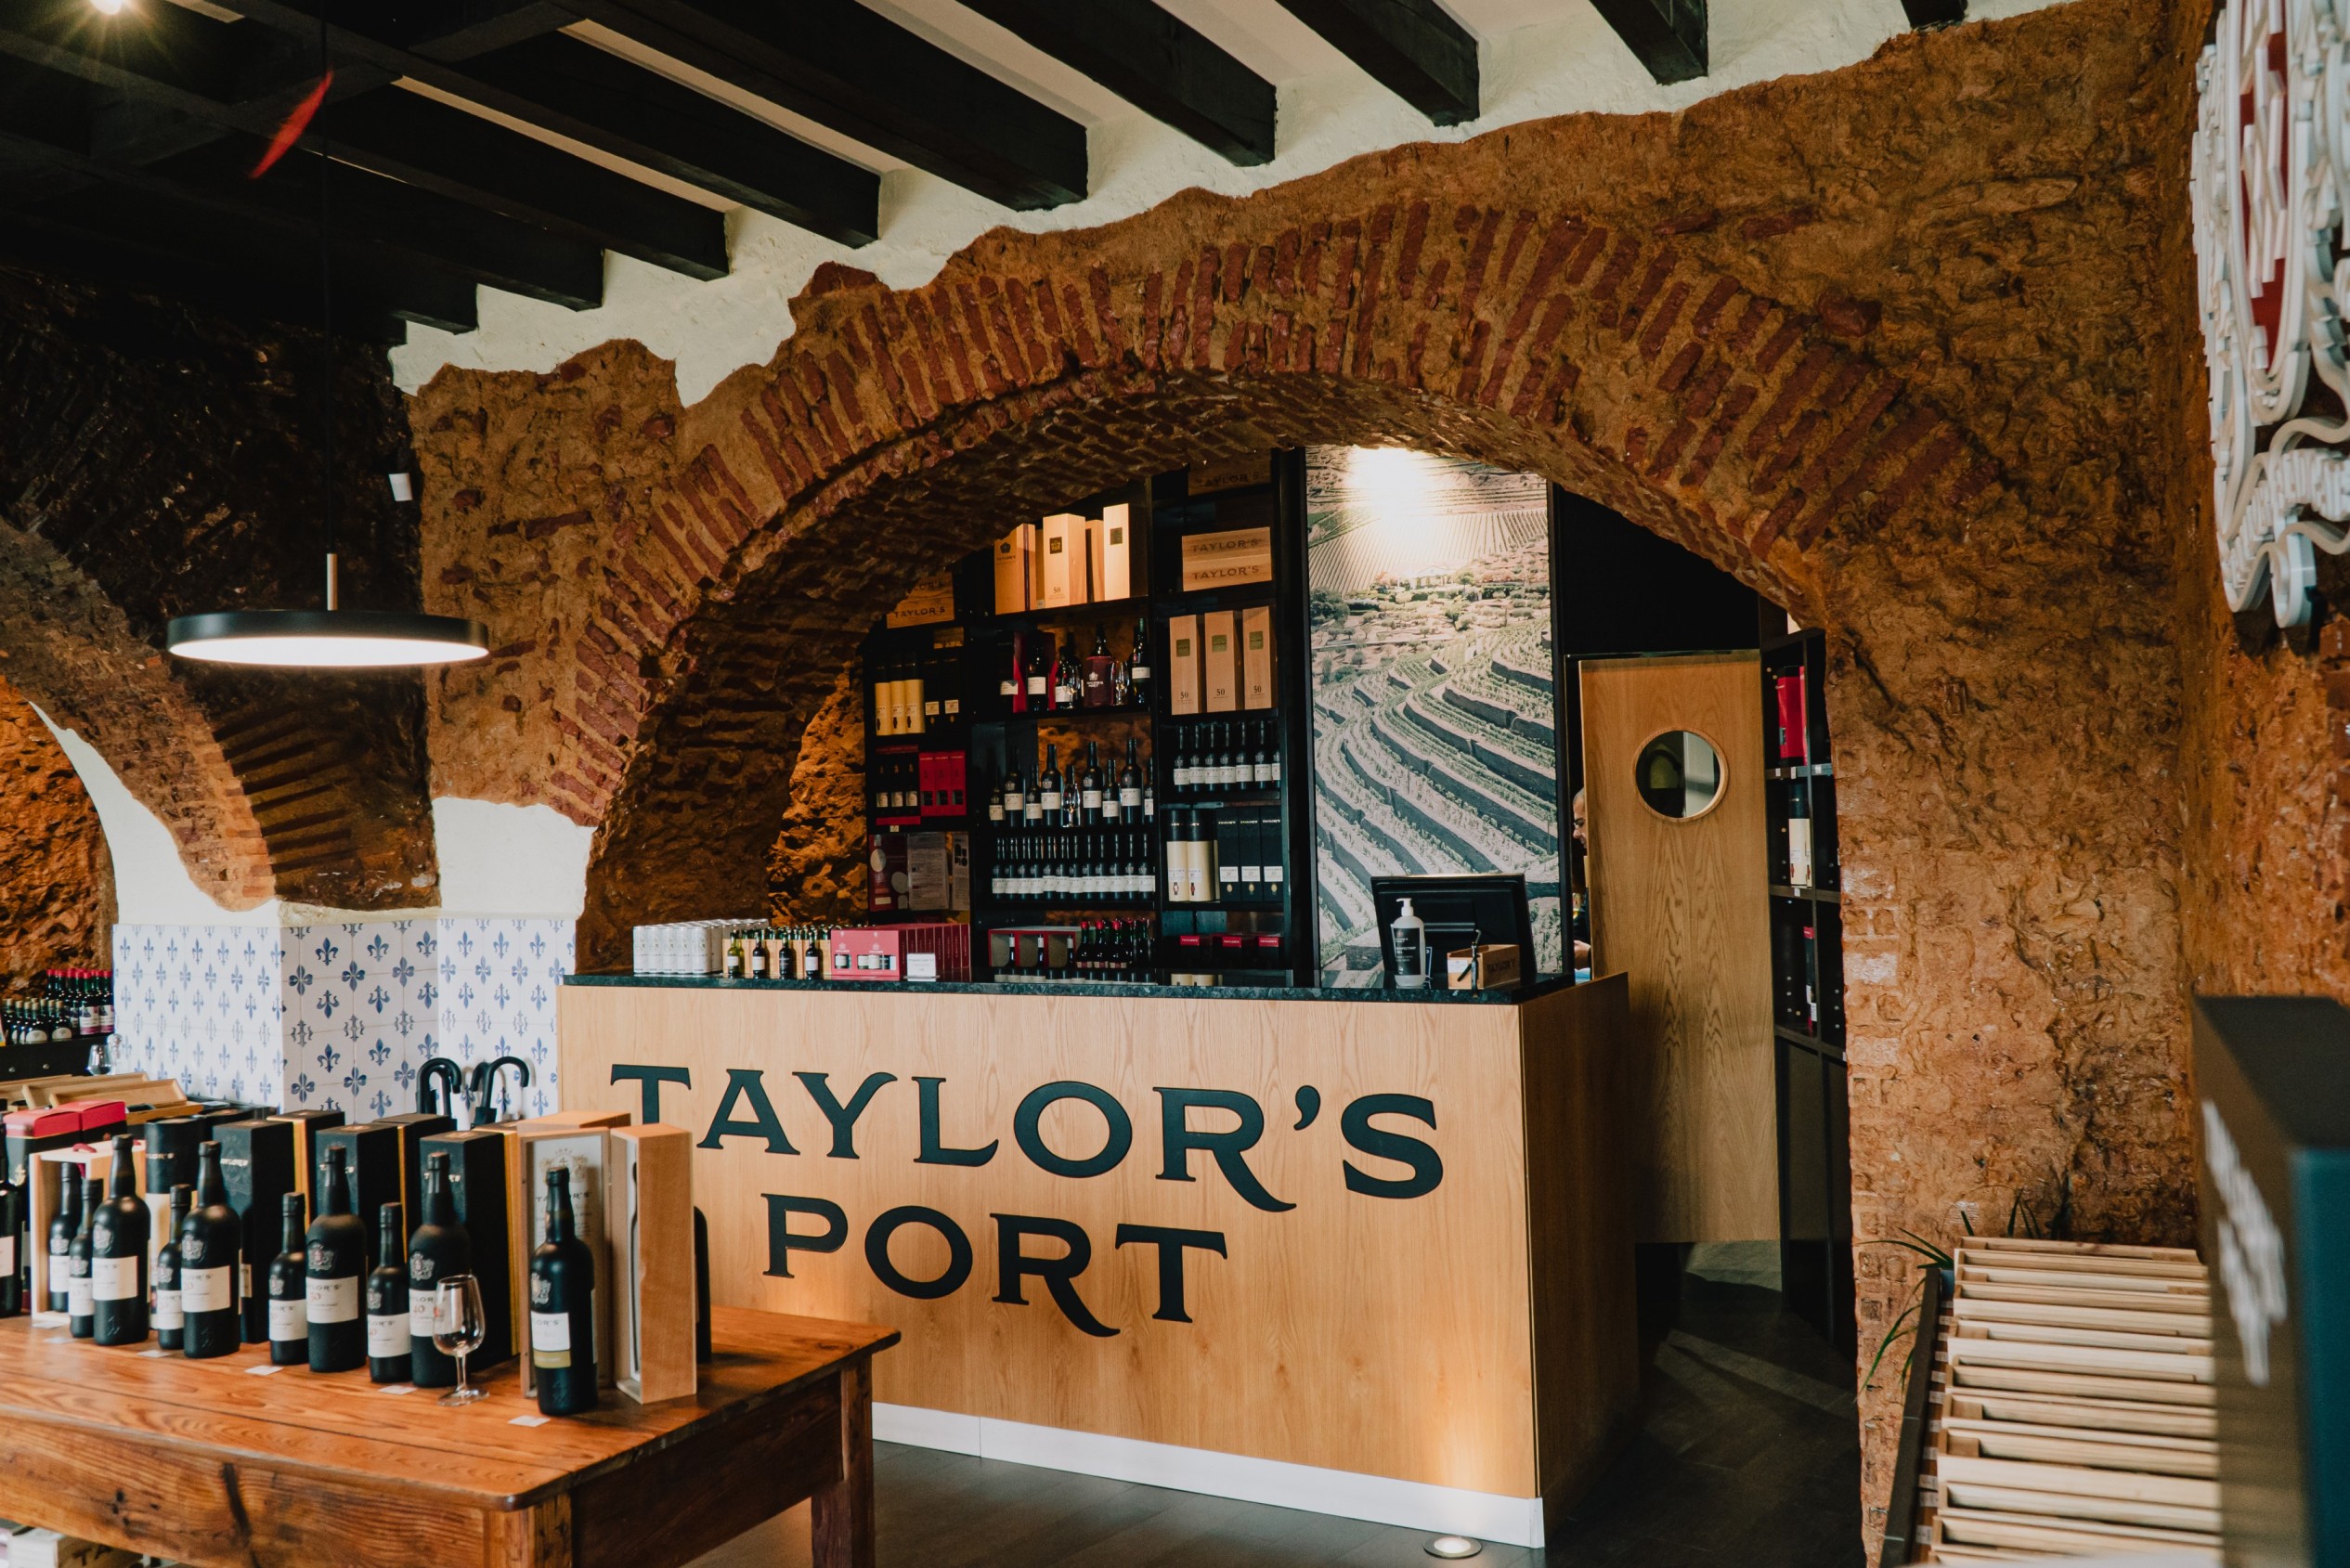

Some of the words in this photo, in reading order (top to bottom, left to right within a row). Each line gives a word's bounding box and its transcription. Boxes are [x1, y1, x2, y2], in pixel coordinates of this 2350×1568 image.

[1192, 538, 1260, 552] TAYLOR'S
[1192, 565, 1260, 580] TAYLOR'S
[894, 605, 946, 619] TAYLOR'S
[1216, 688, 1226, 696] 50
[1253, 685, 1262, 694] 50
[610, 1065, 1444, 1212] TAYLOR'S
[760, 1193, 1228, 1337] PORT
